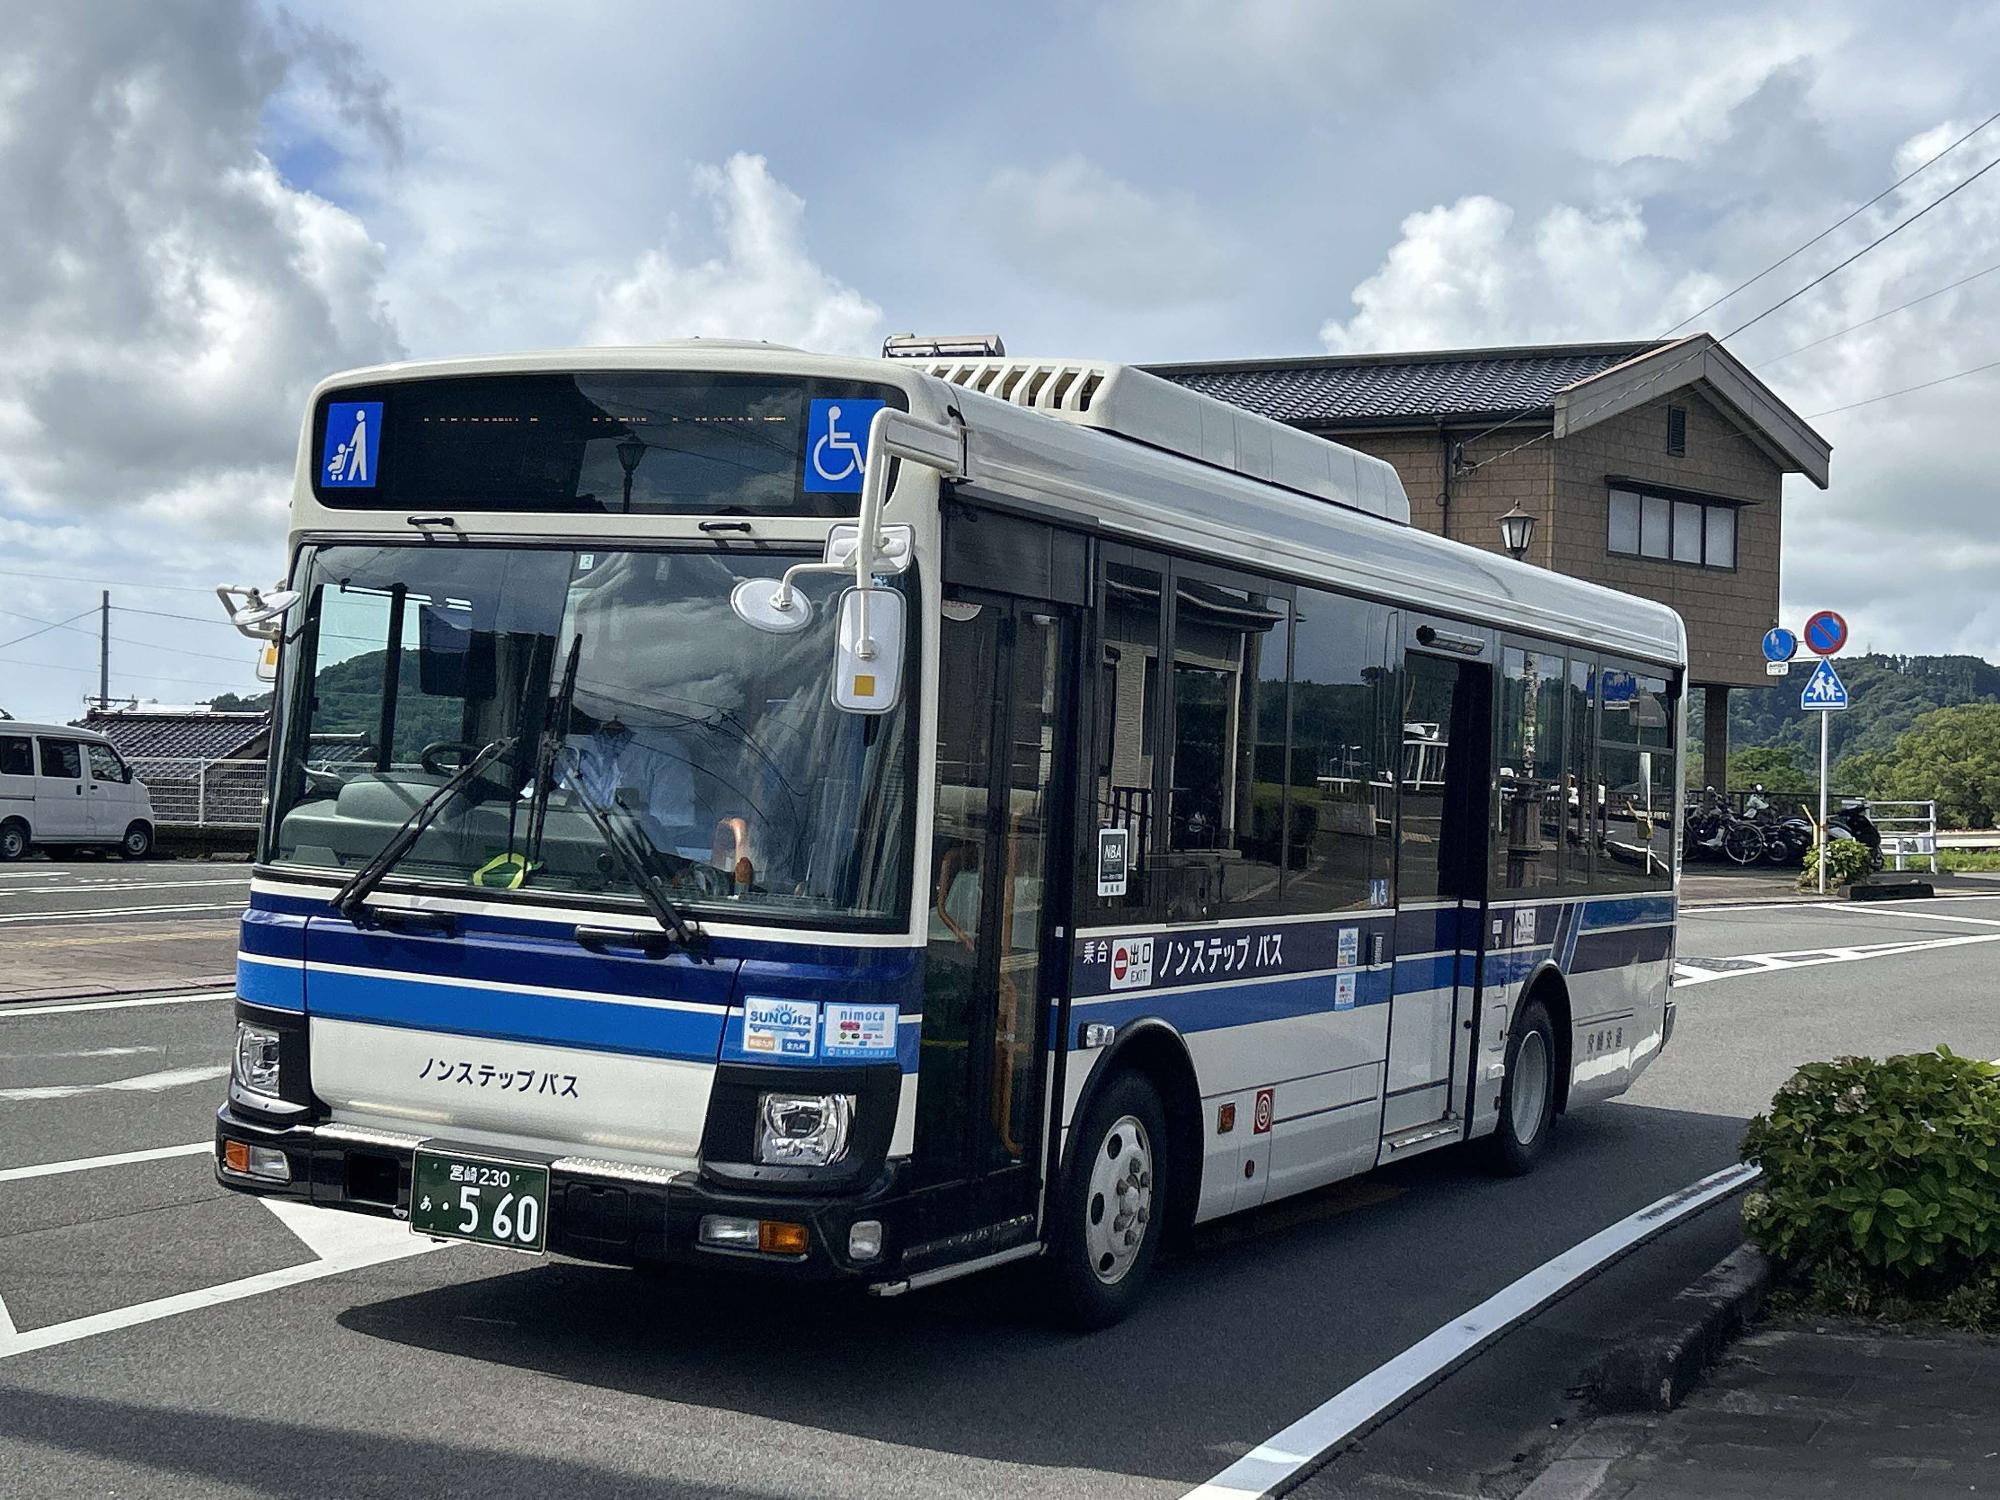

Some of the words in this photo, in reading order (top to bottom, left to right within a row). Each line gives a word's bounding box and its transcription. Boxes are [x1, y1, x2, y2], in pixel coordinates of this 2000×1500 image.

[1083, 940, 1108, 964] 乗合
[1129, 943, 1151, 966] 出口
[1130, 969, 1148, 983] EXIT
[840, 1010, 885, 1021] nimoca
[419, 1058, 579, 1098] ノンステップバス
[420, 1195, 432, 1212] あ
